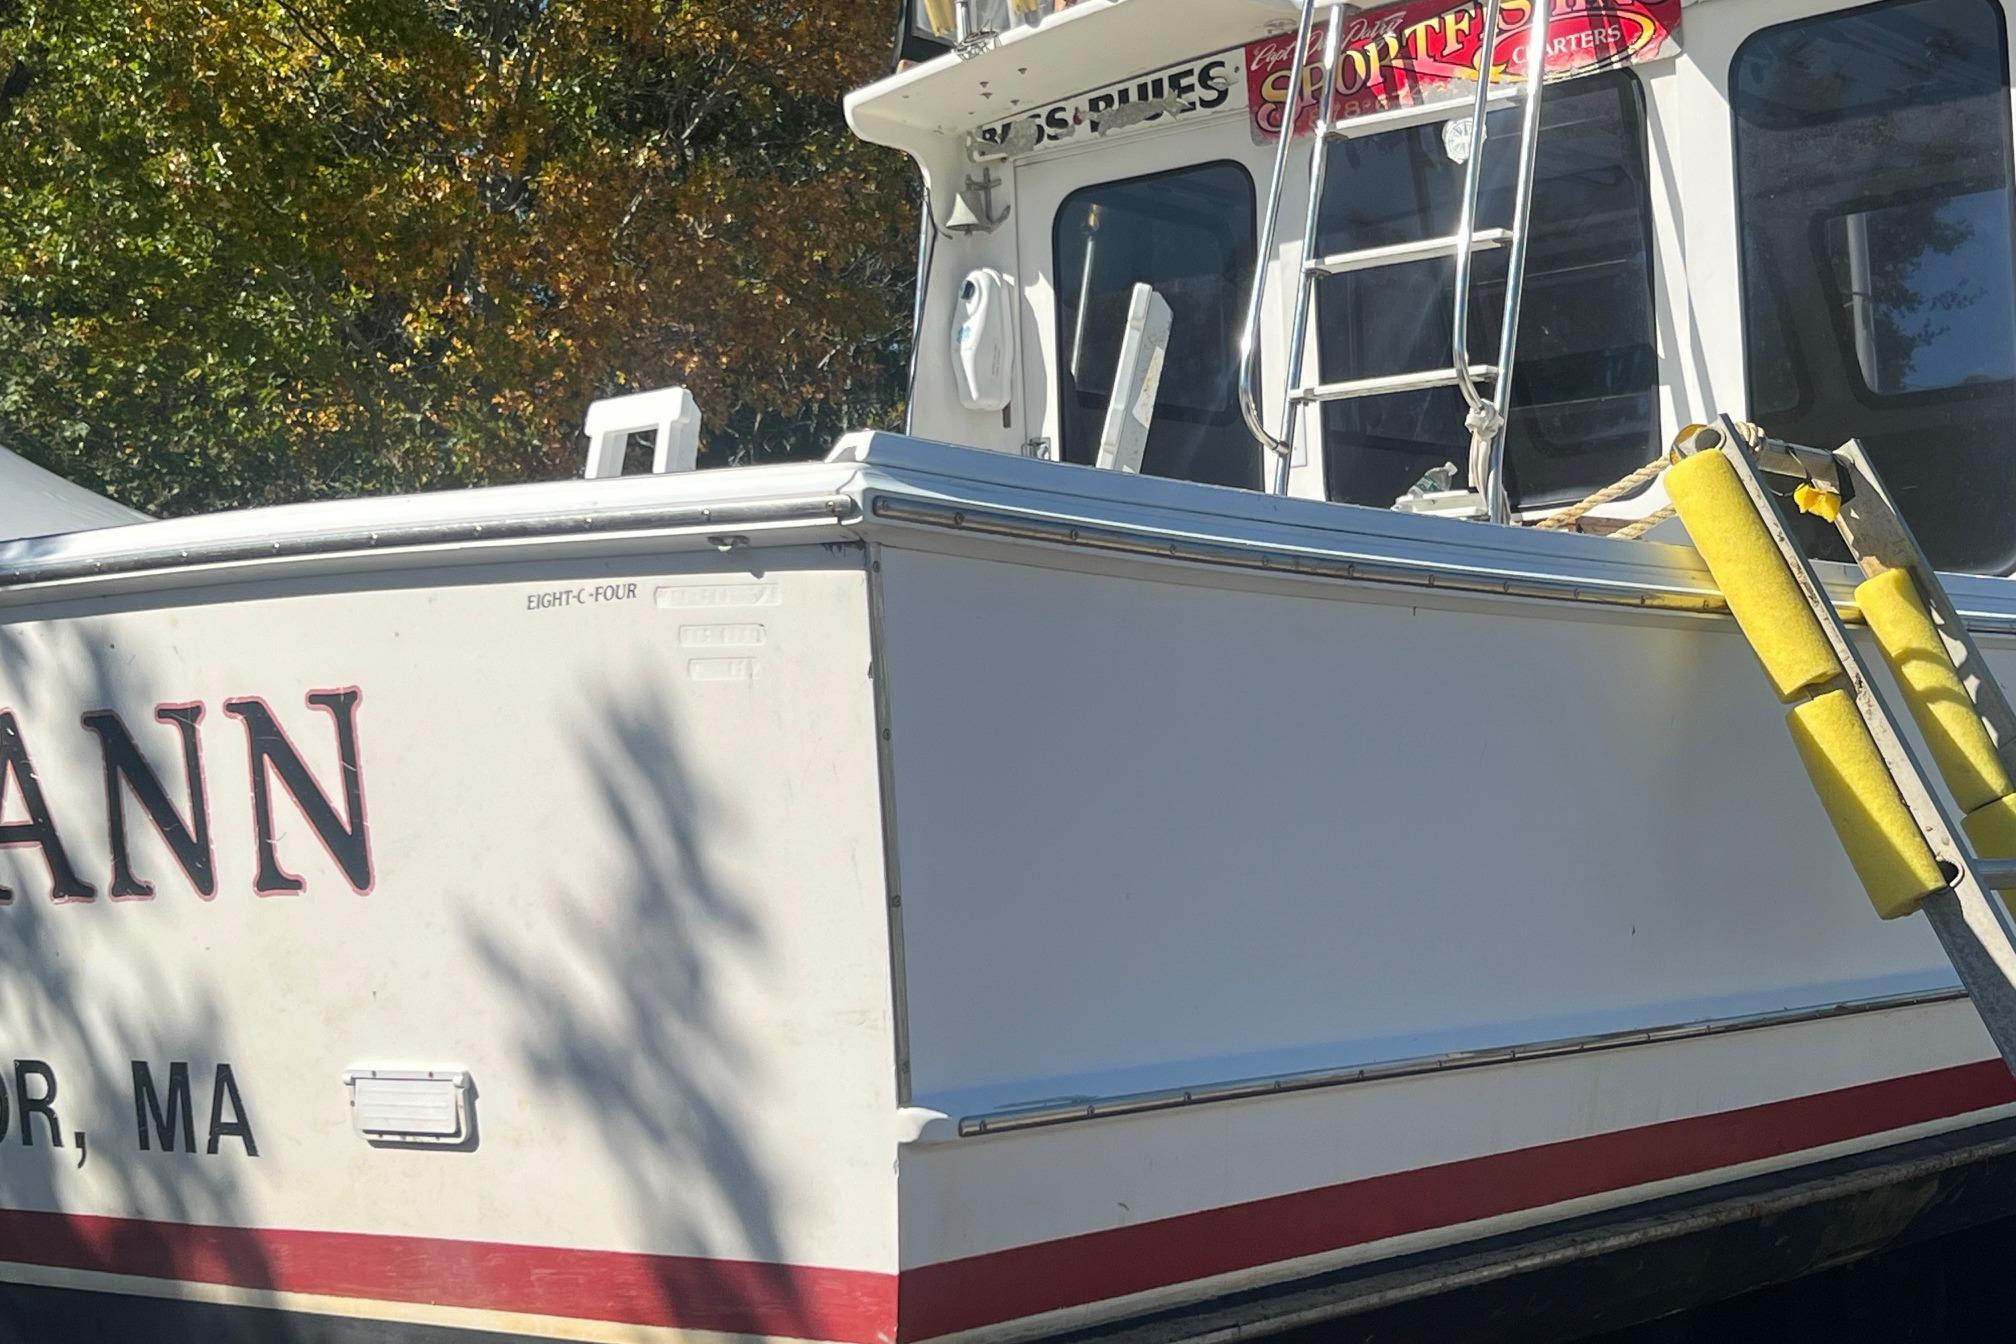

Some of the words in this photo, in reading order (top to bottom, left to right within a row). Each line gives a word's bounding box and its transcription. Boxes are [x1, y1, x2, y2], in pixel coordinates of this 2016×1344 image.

[1512, 25, 1621, 64] CARTERS
[0, 684, 377, 904] ANN
[0, 1059, 88, 1169] R,
[131, 1060, 260, 1157] MA
